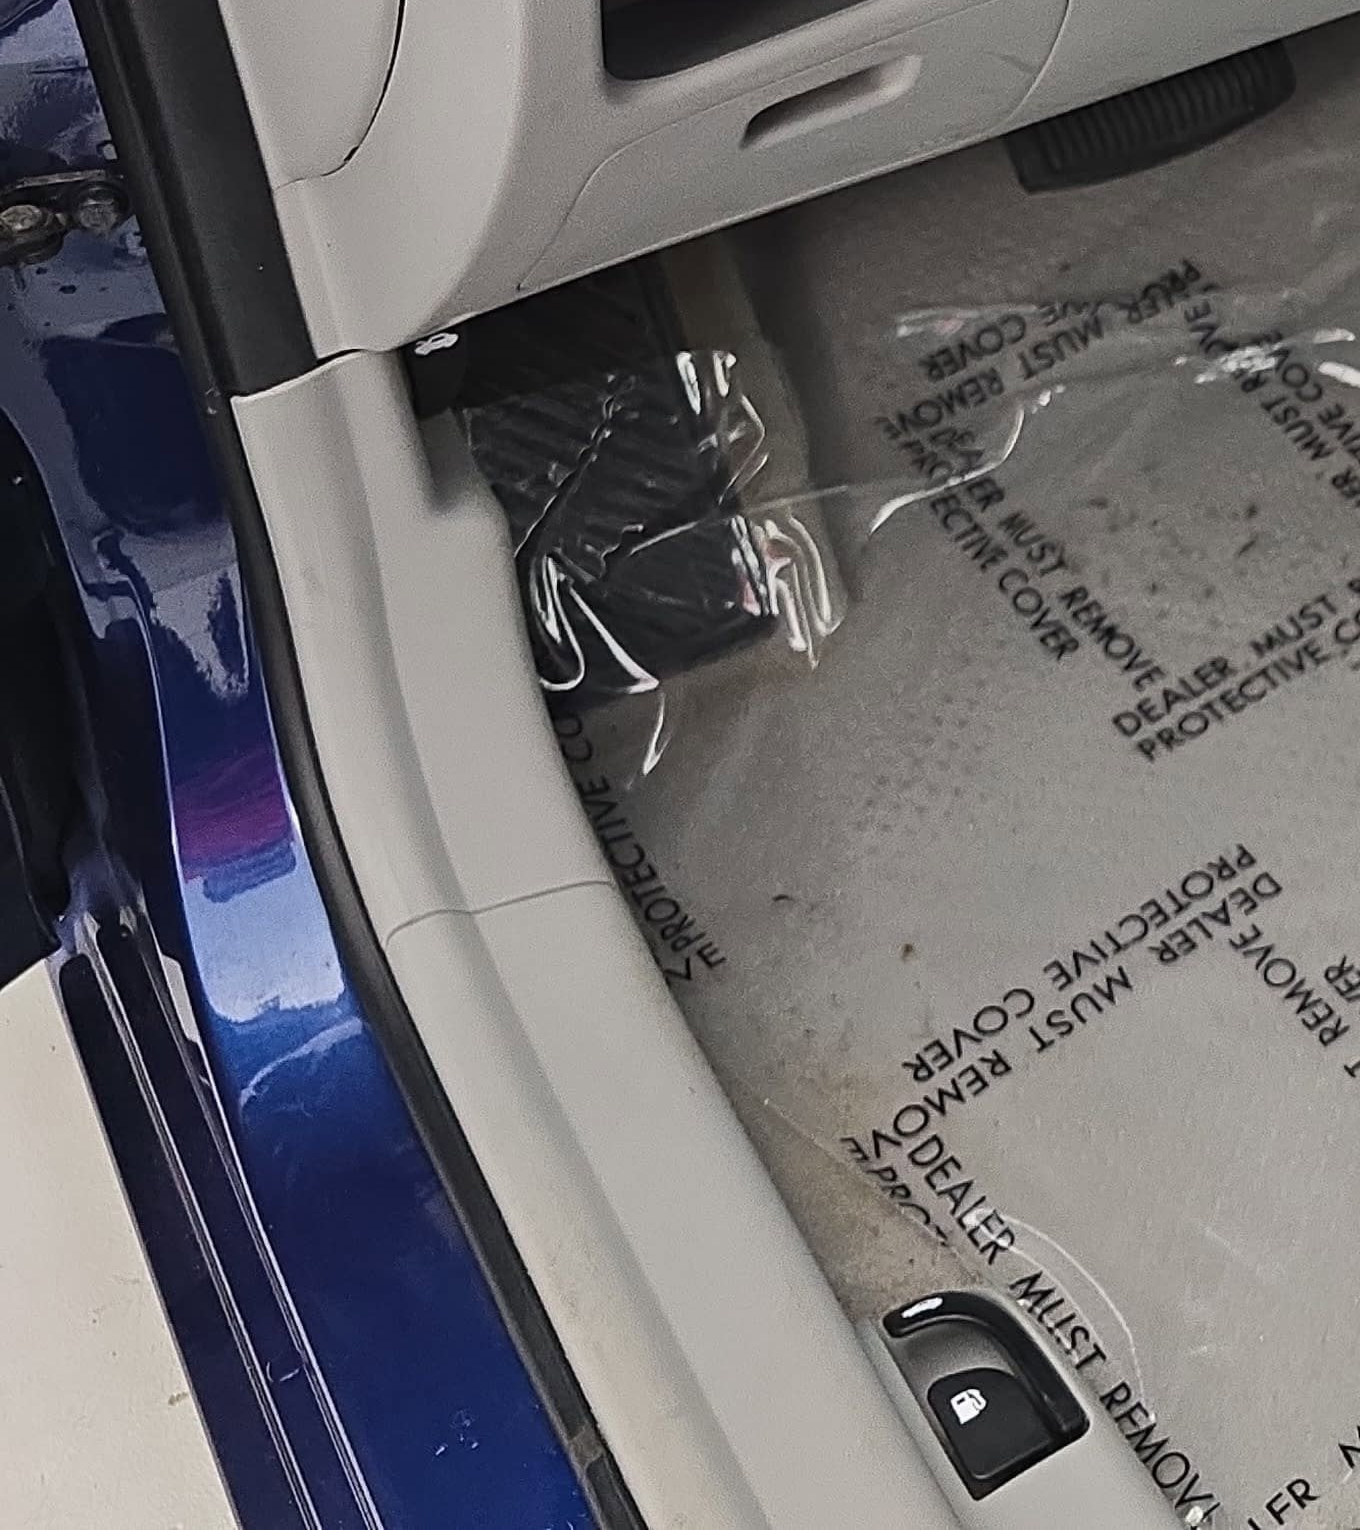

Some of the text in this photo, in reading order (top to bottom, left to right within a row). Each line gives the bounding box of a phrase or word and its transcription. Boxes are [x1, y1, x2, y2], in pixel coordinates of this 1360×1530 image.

[917, 313, 1027, 382] COVER
[1018, 314, 1105, 381] MUST
[1260, 396, 1336, 462] MUST
[997, 568, 1081, 662] COVER
[998, 509, 1068, 578] MUST
[1059, 584, 1167, 694] REMOVE
[1111, 655, 1232, 740] DEALER
[1249, 593, 1339, 660] MUST
[1135, 638, 1331, 762] PROTECTIVE
[840, 870, 1284, 1163] DEALER MUST REMOVE
[902, 843, 1257, 1083] PROTECTIVE COVER
[1229, 923, 1350, 1047] REMOVE
[906, 1133, 1016, 1266] DEALER
[1008, 1269, 1108, 1371] MUST
